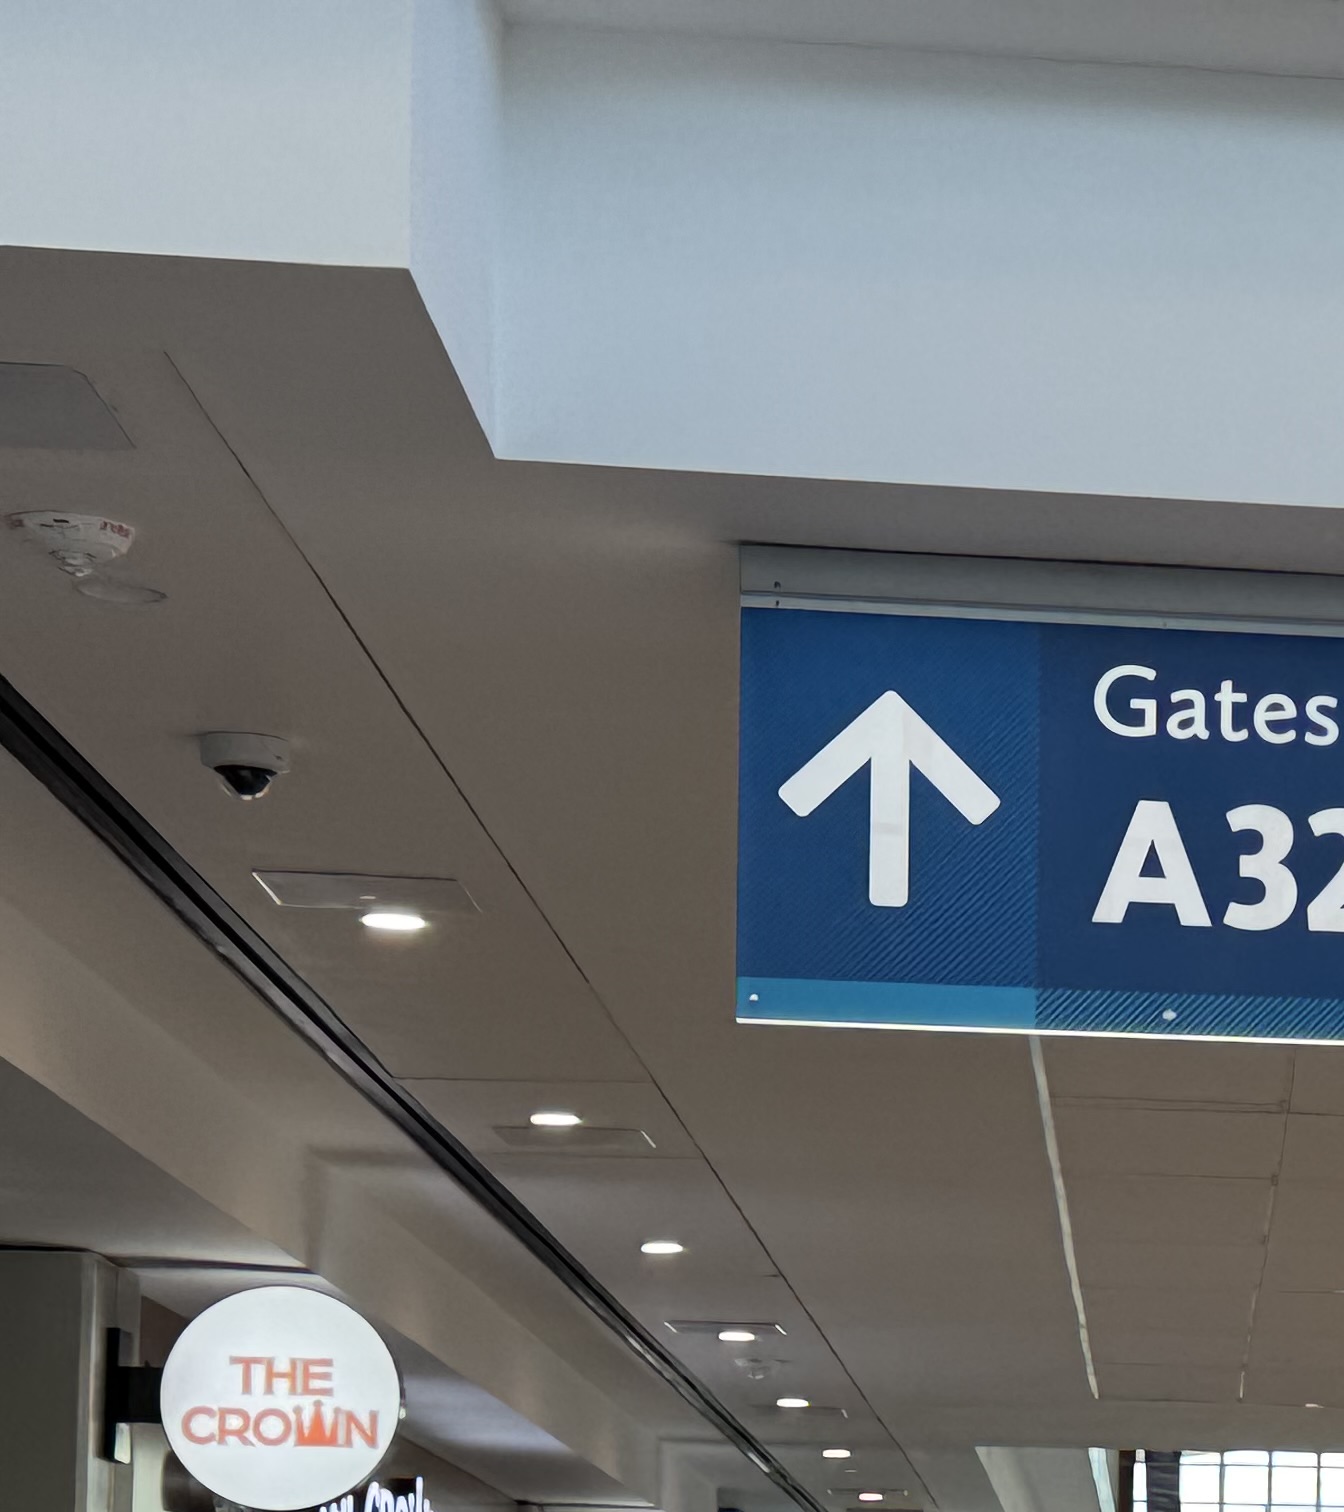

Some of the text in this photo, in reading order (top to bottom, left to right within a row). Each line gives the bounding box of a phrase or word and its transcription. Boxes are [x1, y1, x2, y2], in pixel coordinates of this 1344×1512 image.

[1093, 663, 1341, 747] Gates
[228, 1355, 334, 1397] THE
[180, 1399, 380, 1449] CROWN
